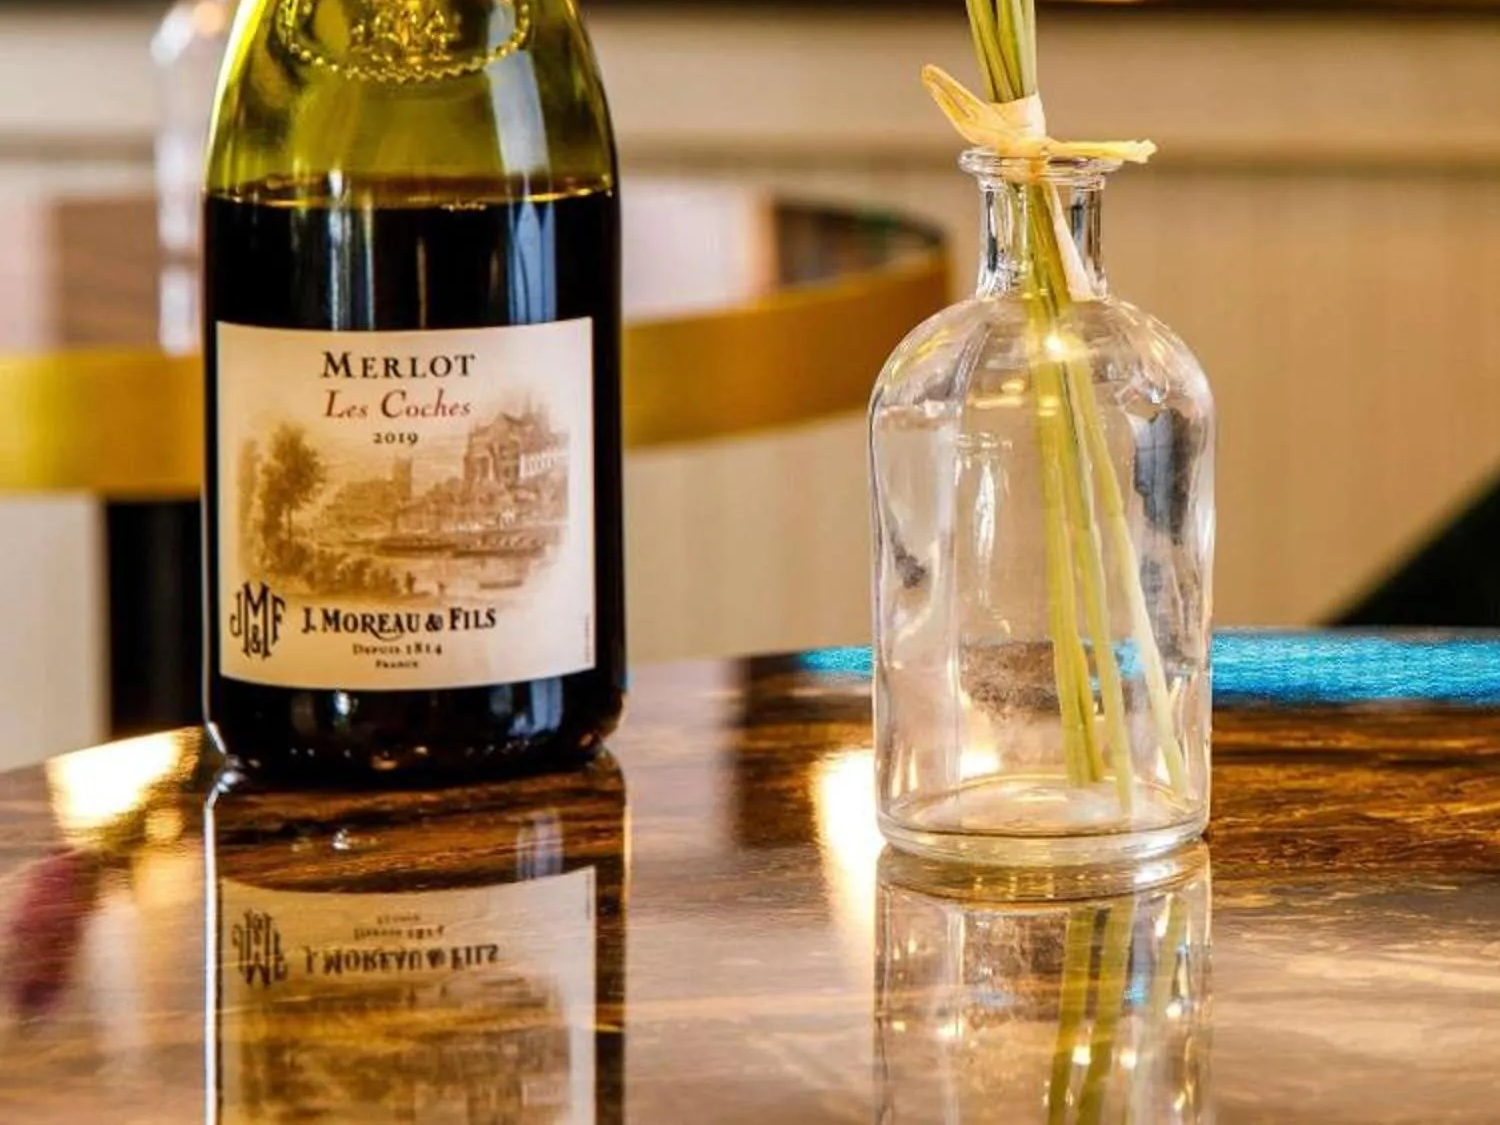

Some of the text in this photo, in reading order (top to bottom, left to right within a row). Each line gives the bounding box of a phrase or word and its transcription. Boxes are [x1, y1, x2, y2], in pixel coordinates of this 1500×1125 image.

[321, 350, 476, 379] MERLOT
[325, 388, 471, 419] Les Coches
[373, 431, 419, 445] 2019
[320, 607, 419, 639] MOREAU
[425, 613, 444, 632] &
[449, 607, 497, 633] FILS
[405, 641, 443, 655] 1814
